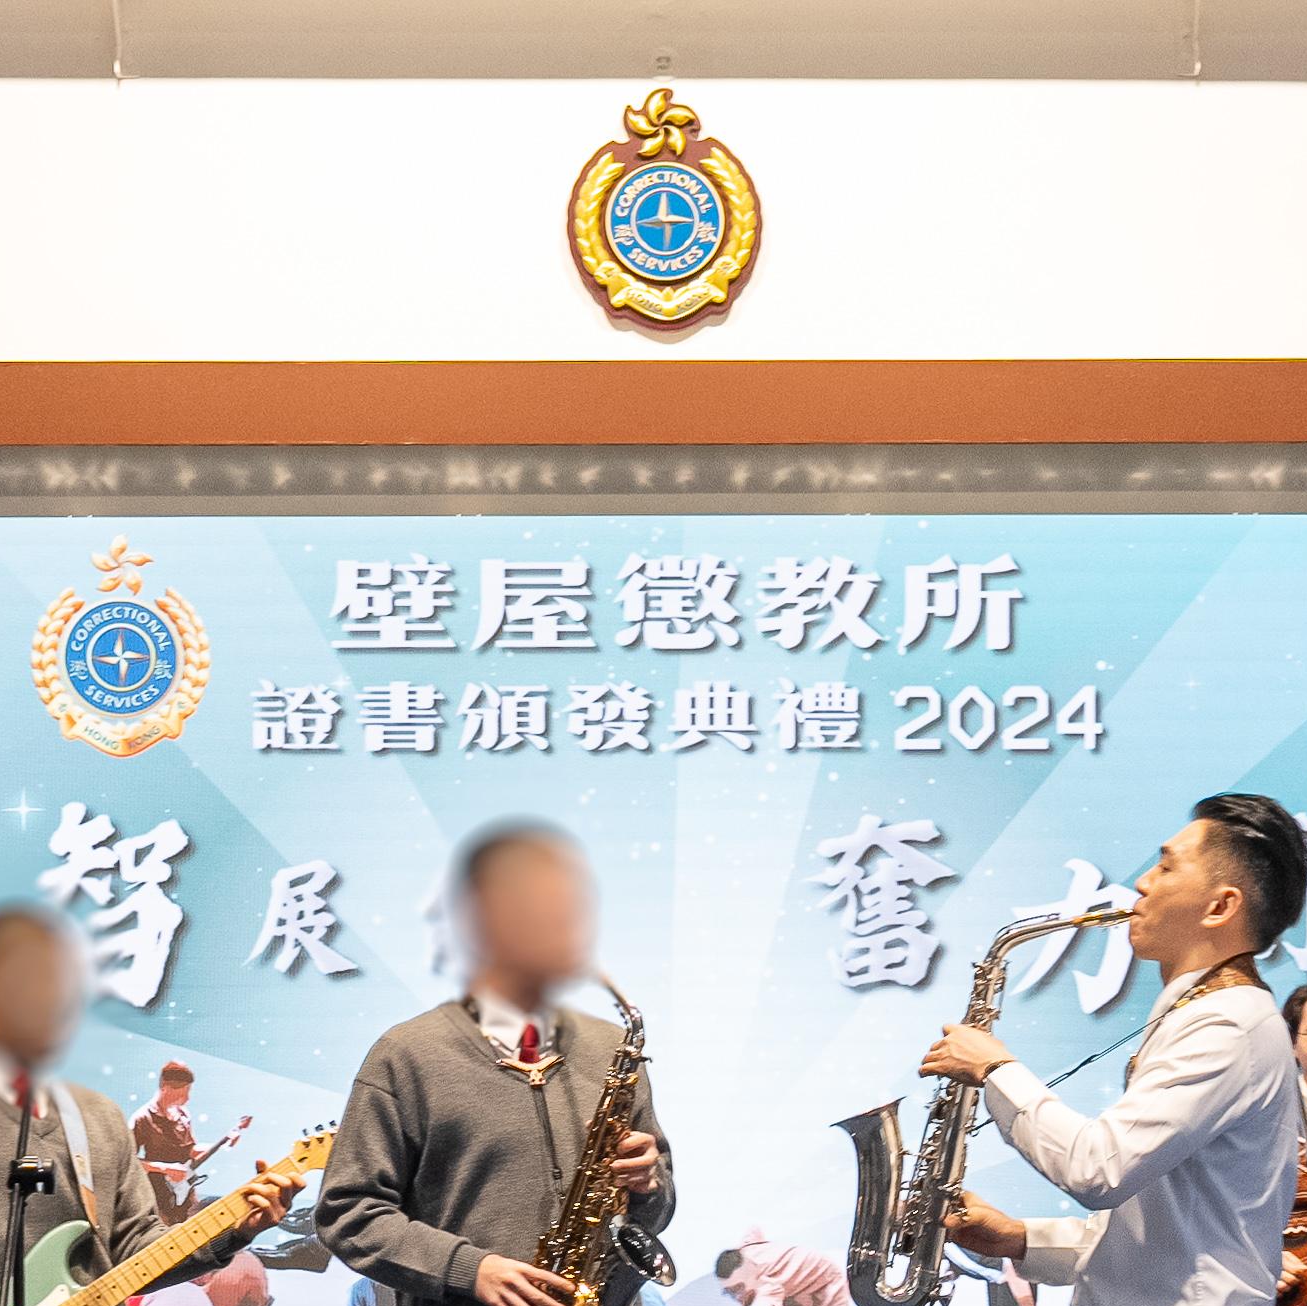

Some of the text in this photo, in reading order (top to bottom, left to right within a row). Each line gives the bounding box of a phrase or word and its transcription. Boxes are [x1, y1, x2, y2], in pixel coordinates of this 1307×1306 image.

[615, 170, 713, 217] CORRECTIONAL
[627, 246, 705, 272] SERVICES
[330, 552, 1024, 652] 壁屋懲教所
[70, 606, 172, 652] CORRECTIONAL
[83, 685, 161, 709] SERVICES
[251, 680, 1105, 752] 證書頒發典禮 2024
